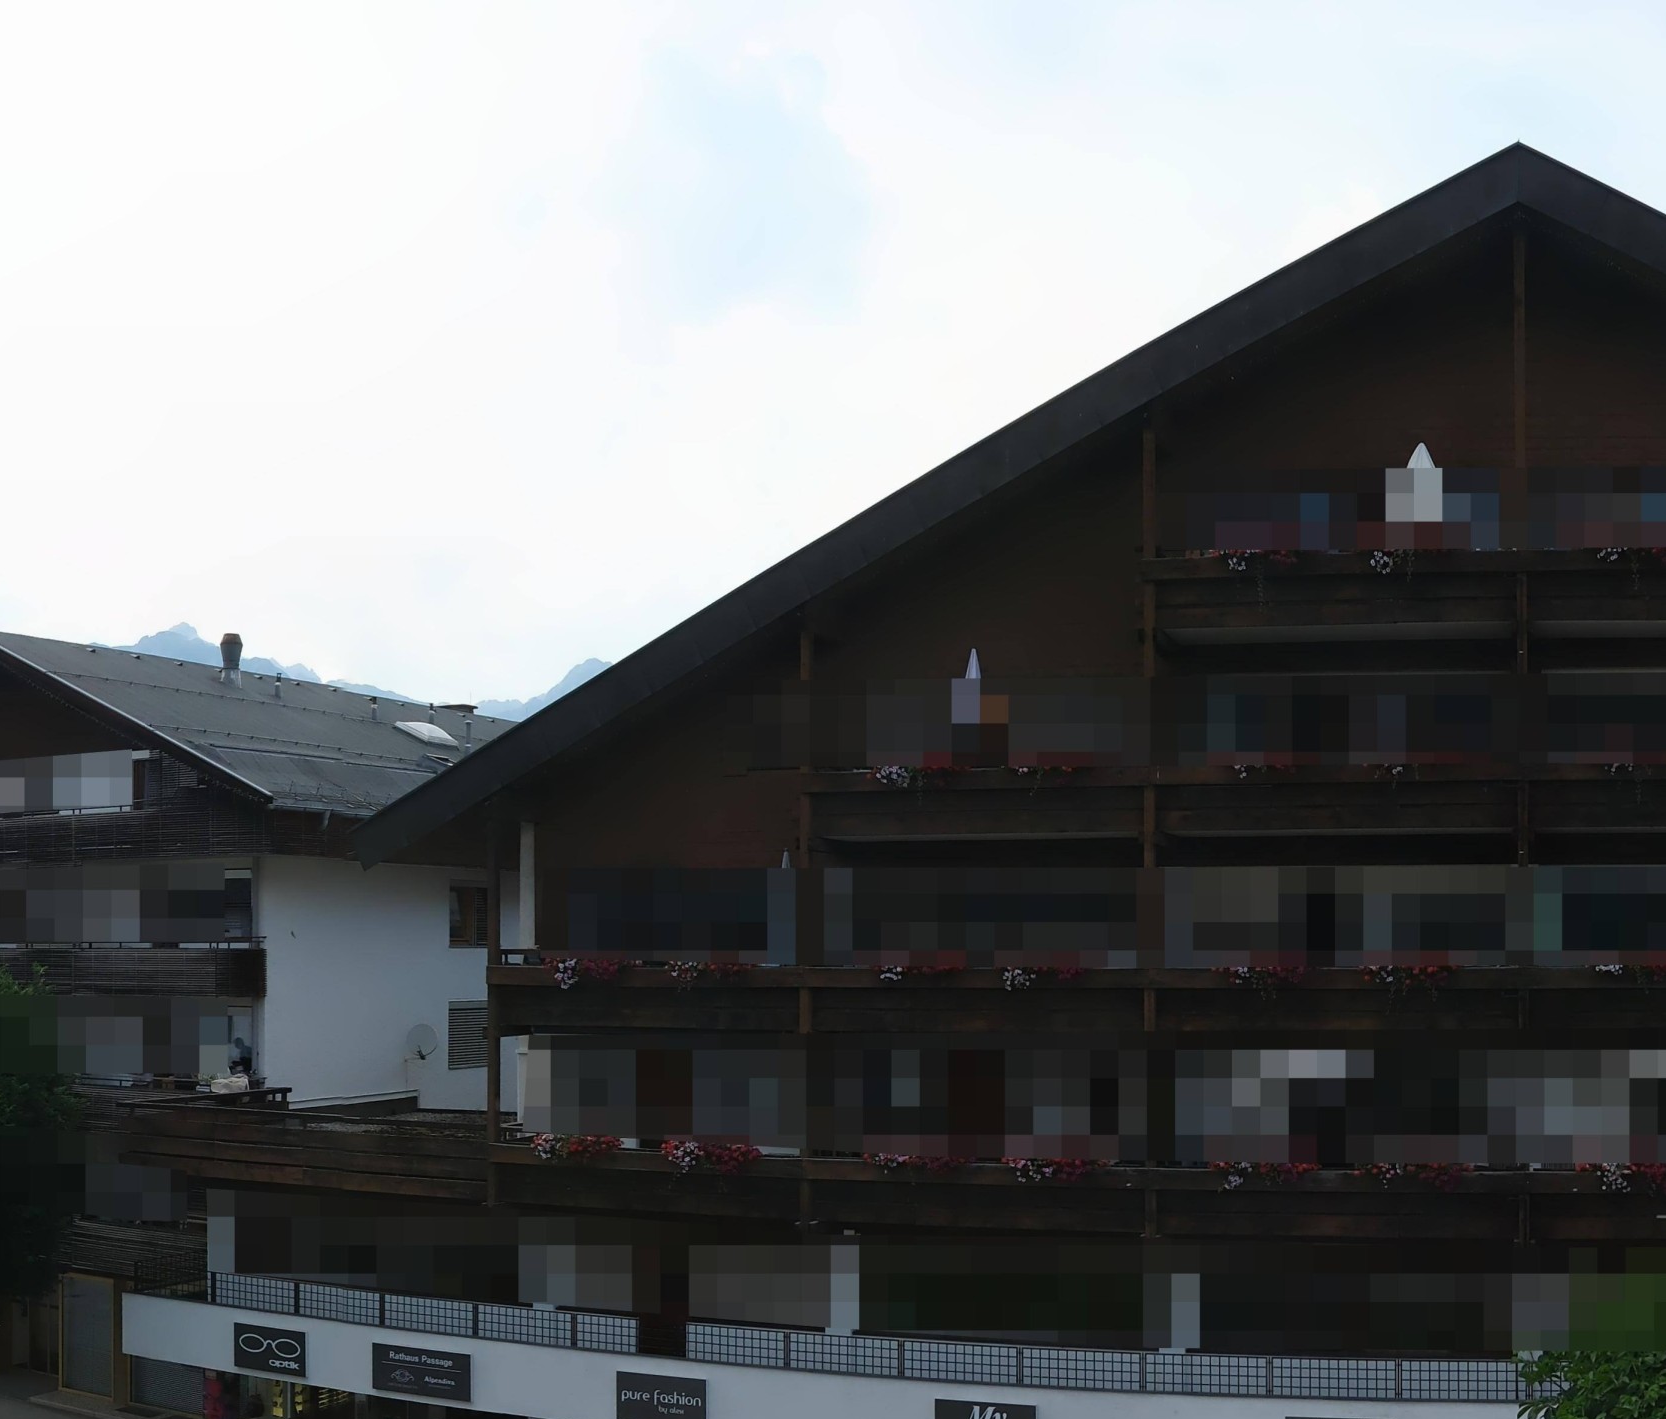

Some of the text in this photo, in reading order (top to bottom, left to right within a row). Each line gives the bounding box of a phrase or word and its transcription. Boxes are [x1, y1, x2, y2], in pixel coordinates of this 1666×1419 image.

[269, 1358, 300, 1370] optik
[389, 1351, 454, 1368] Rathaus Passage
[622, 1389, 701, 1407] pure fashion
